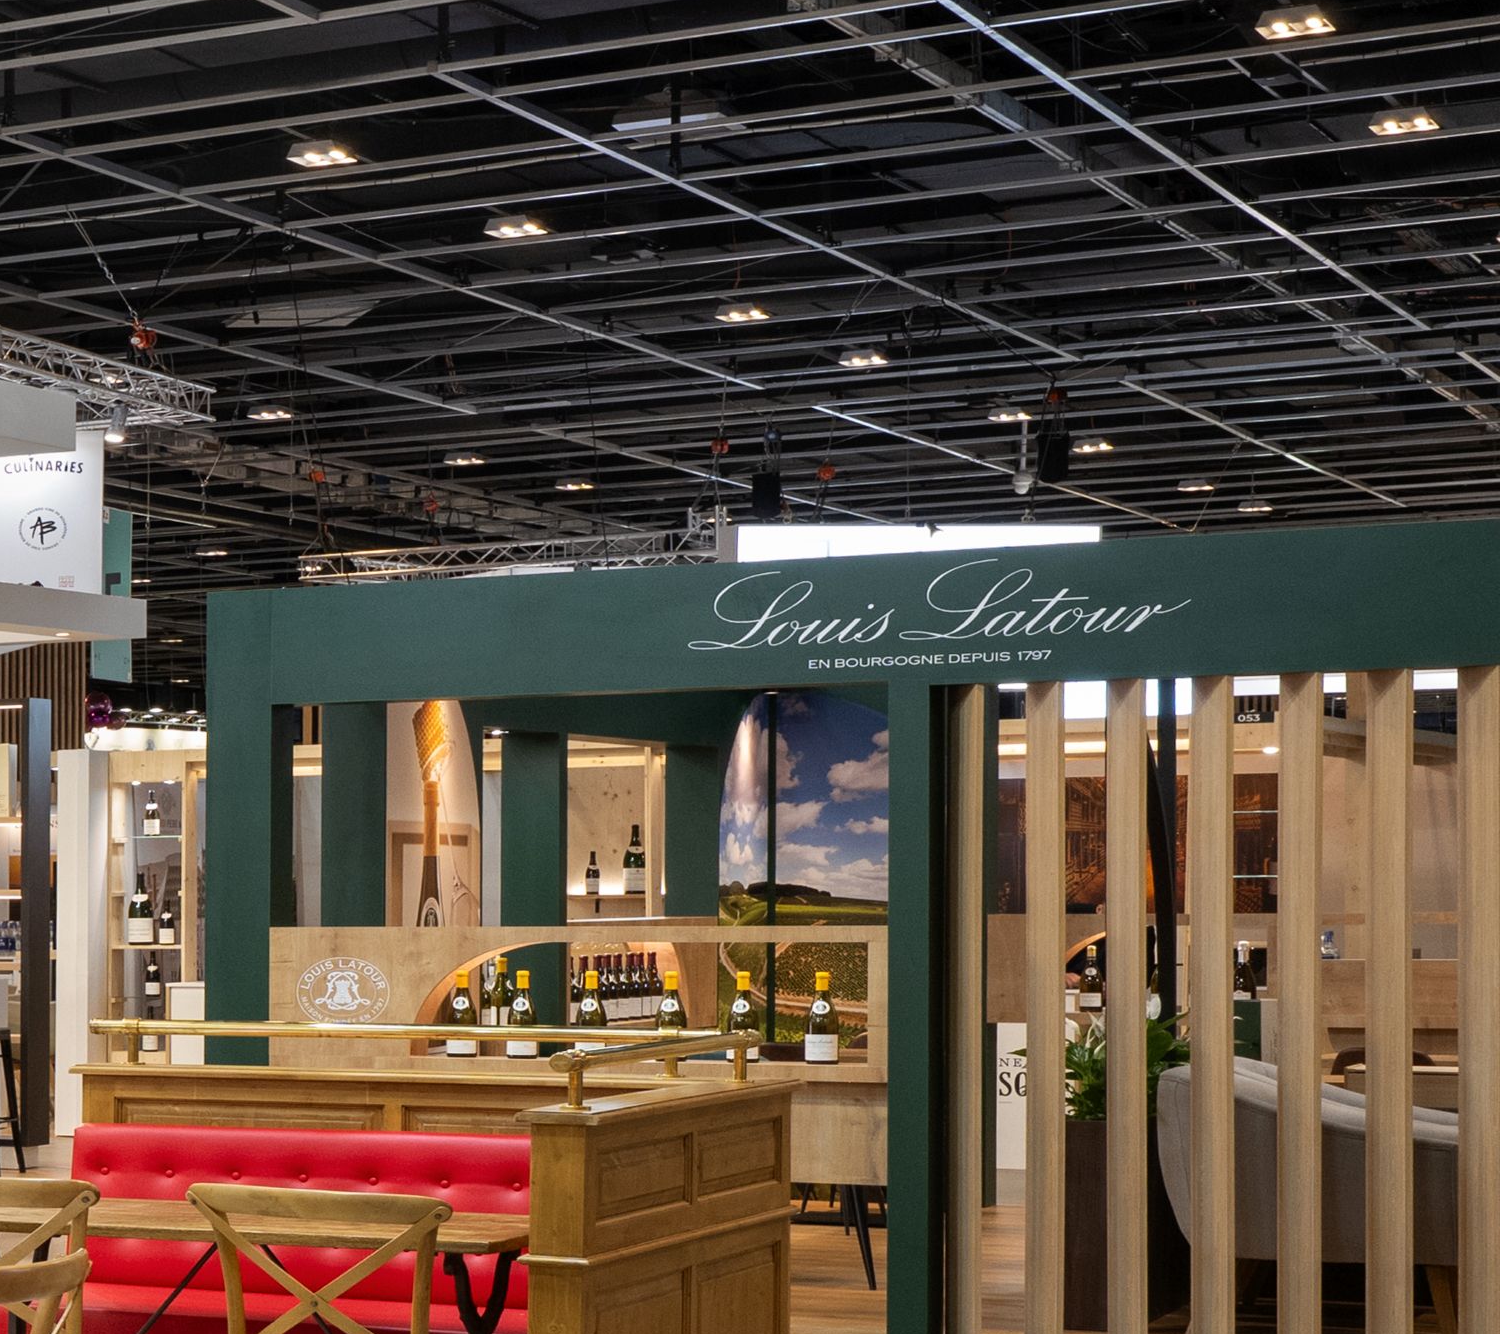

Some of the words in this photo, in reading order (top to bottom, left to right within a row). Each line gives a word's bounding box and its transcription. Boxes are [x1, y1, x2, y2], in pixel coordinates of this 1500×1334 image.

[687, 571, 896, 650] Louis
[899, 559, 1192, 641] Latour
[808, 658, 833, 670] EN
[834, 654, 945, 668] BOURGOGNE
[948, 651, 1011, 664] DEPUIS
[1017, 649, 1052, 662] 1797
[1237, 713, 1260, 722] 053
[300, 960, 333, 989] LOUIS
[339, 959, 386, 990] LATOUR
[300, 995, 324, 1020] MAISON
